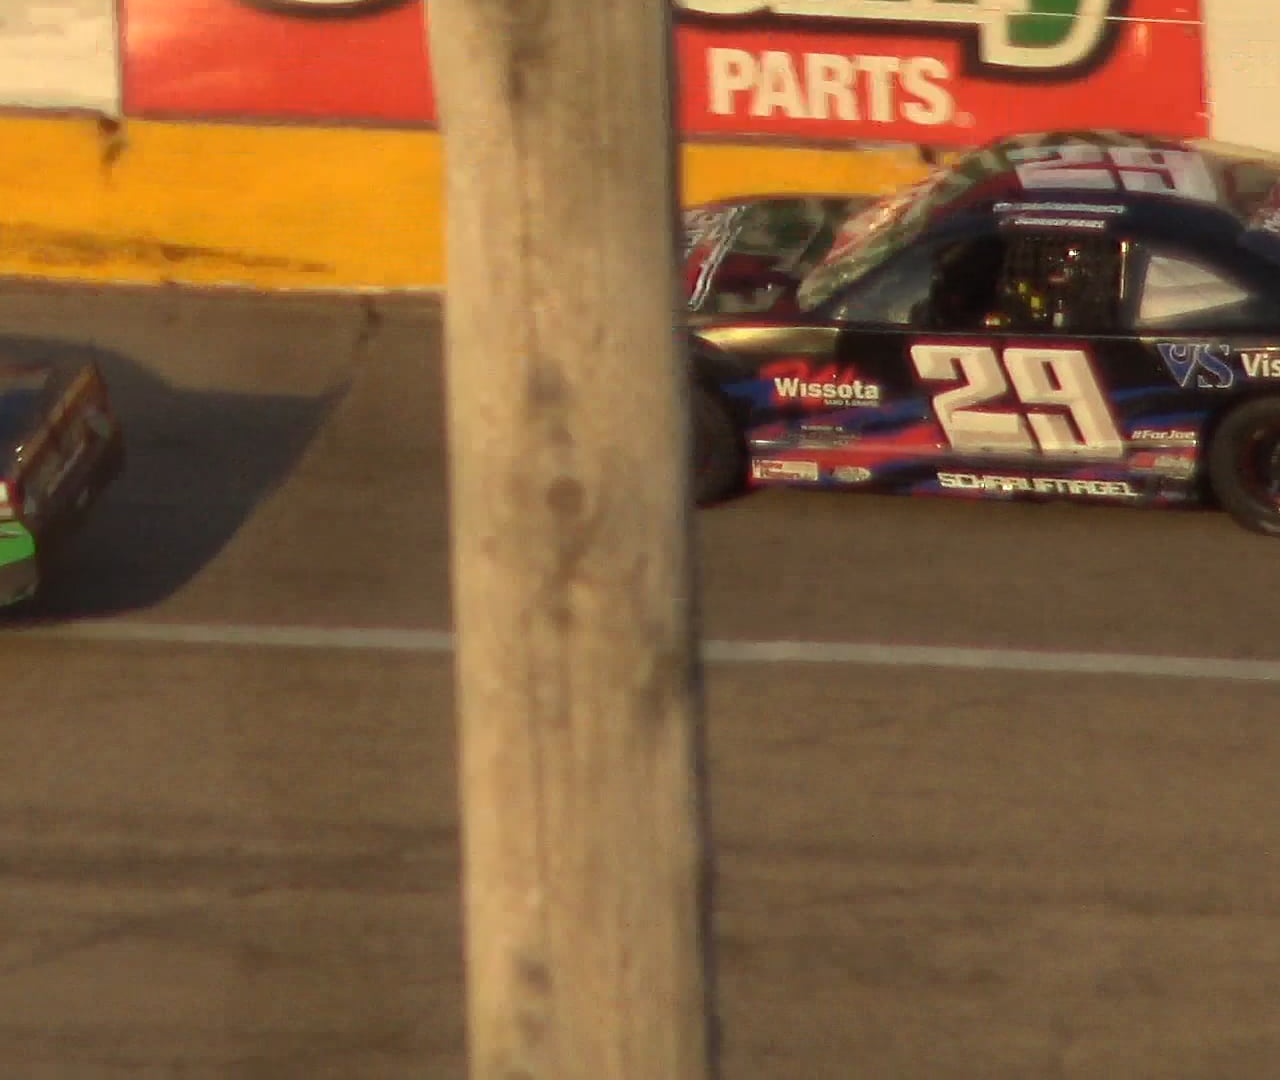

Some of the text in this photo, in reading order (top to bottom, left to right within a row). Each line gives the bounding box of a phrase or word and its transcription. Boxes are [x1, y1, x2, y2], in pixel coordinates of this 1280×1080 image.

[706, 47, 956, 126] PARTS
[773, 376, 881, 400] Wissota
[910, 343, 1123, 459] 29
